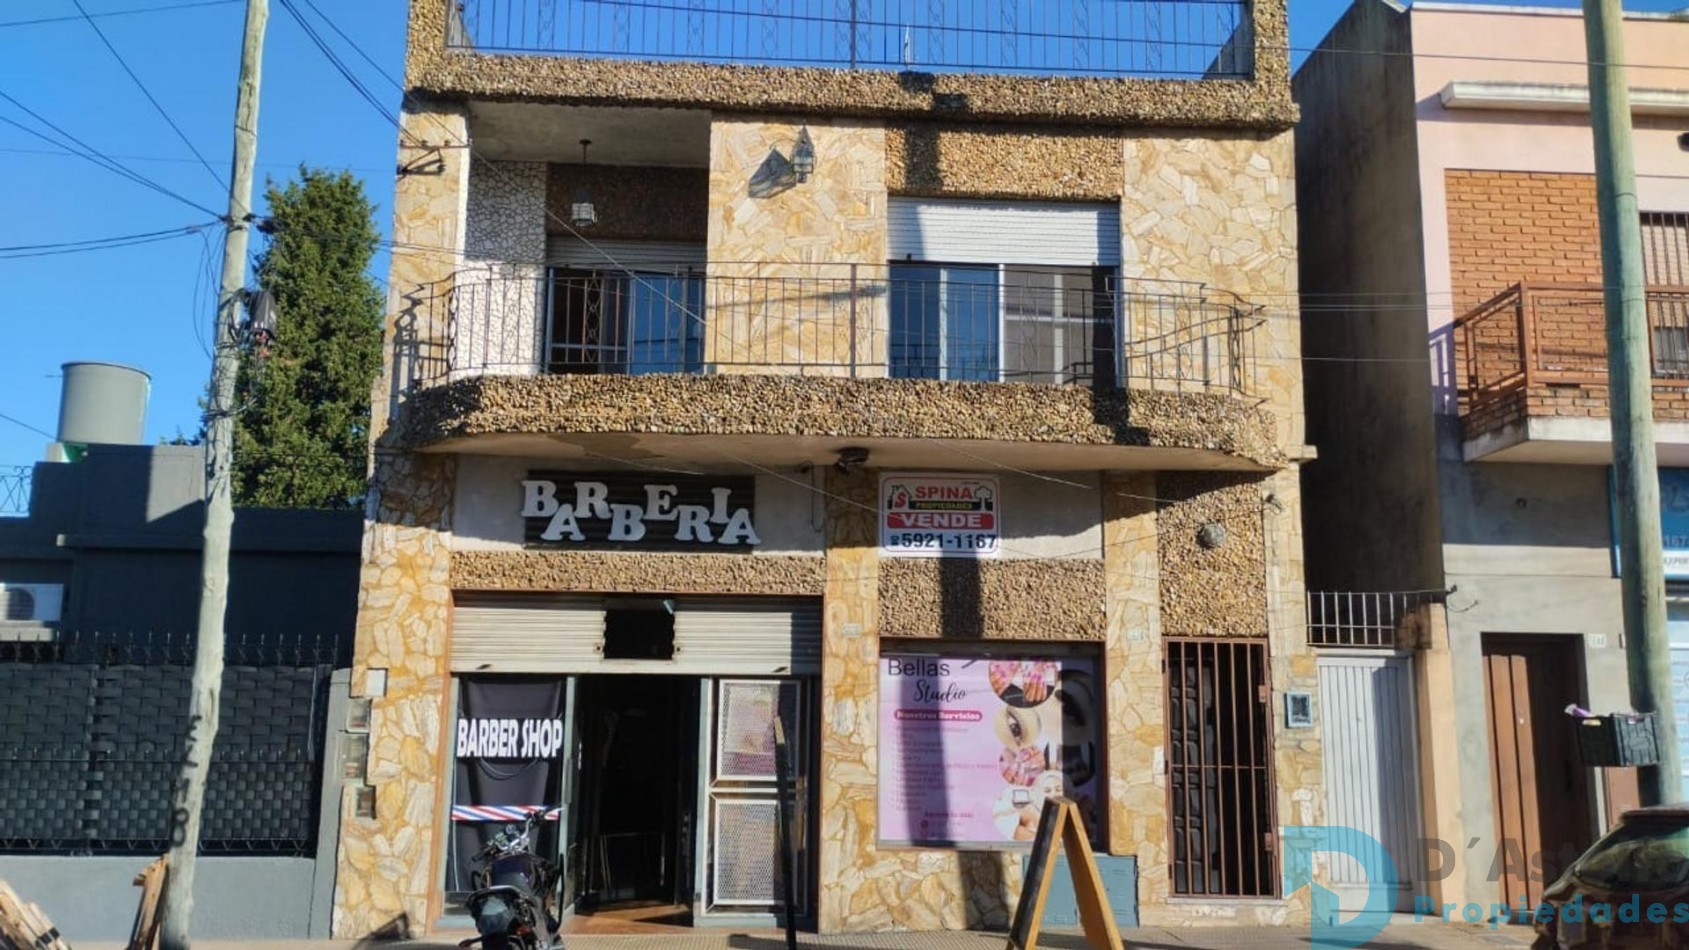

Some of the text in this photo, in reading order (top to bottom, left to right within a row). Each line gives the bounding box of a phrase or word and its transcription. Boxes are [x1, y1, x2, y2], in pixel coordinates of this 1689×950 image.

[915, 485, 973, 499] SPINA
[521, 480, 760, 545] BARBERIA
[901, 513, 982, 528] VENDE
[901, 533, 996, 549] 5921-1167
[888, 658, 950, 677] Bellas
[913, 679, 966, 704] Studio
[456, 718, 563, 758] BARBER SHOP
